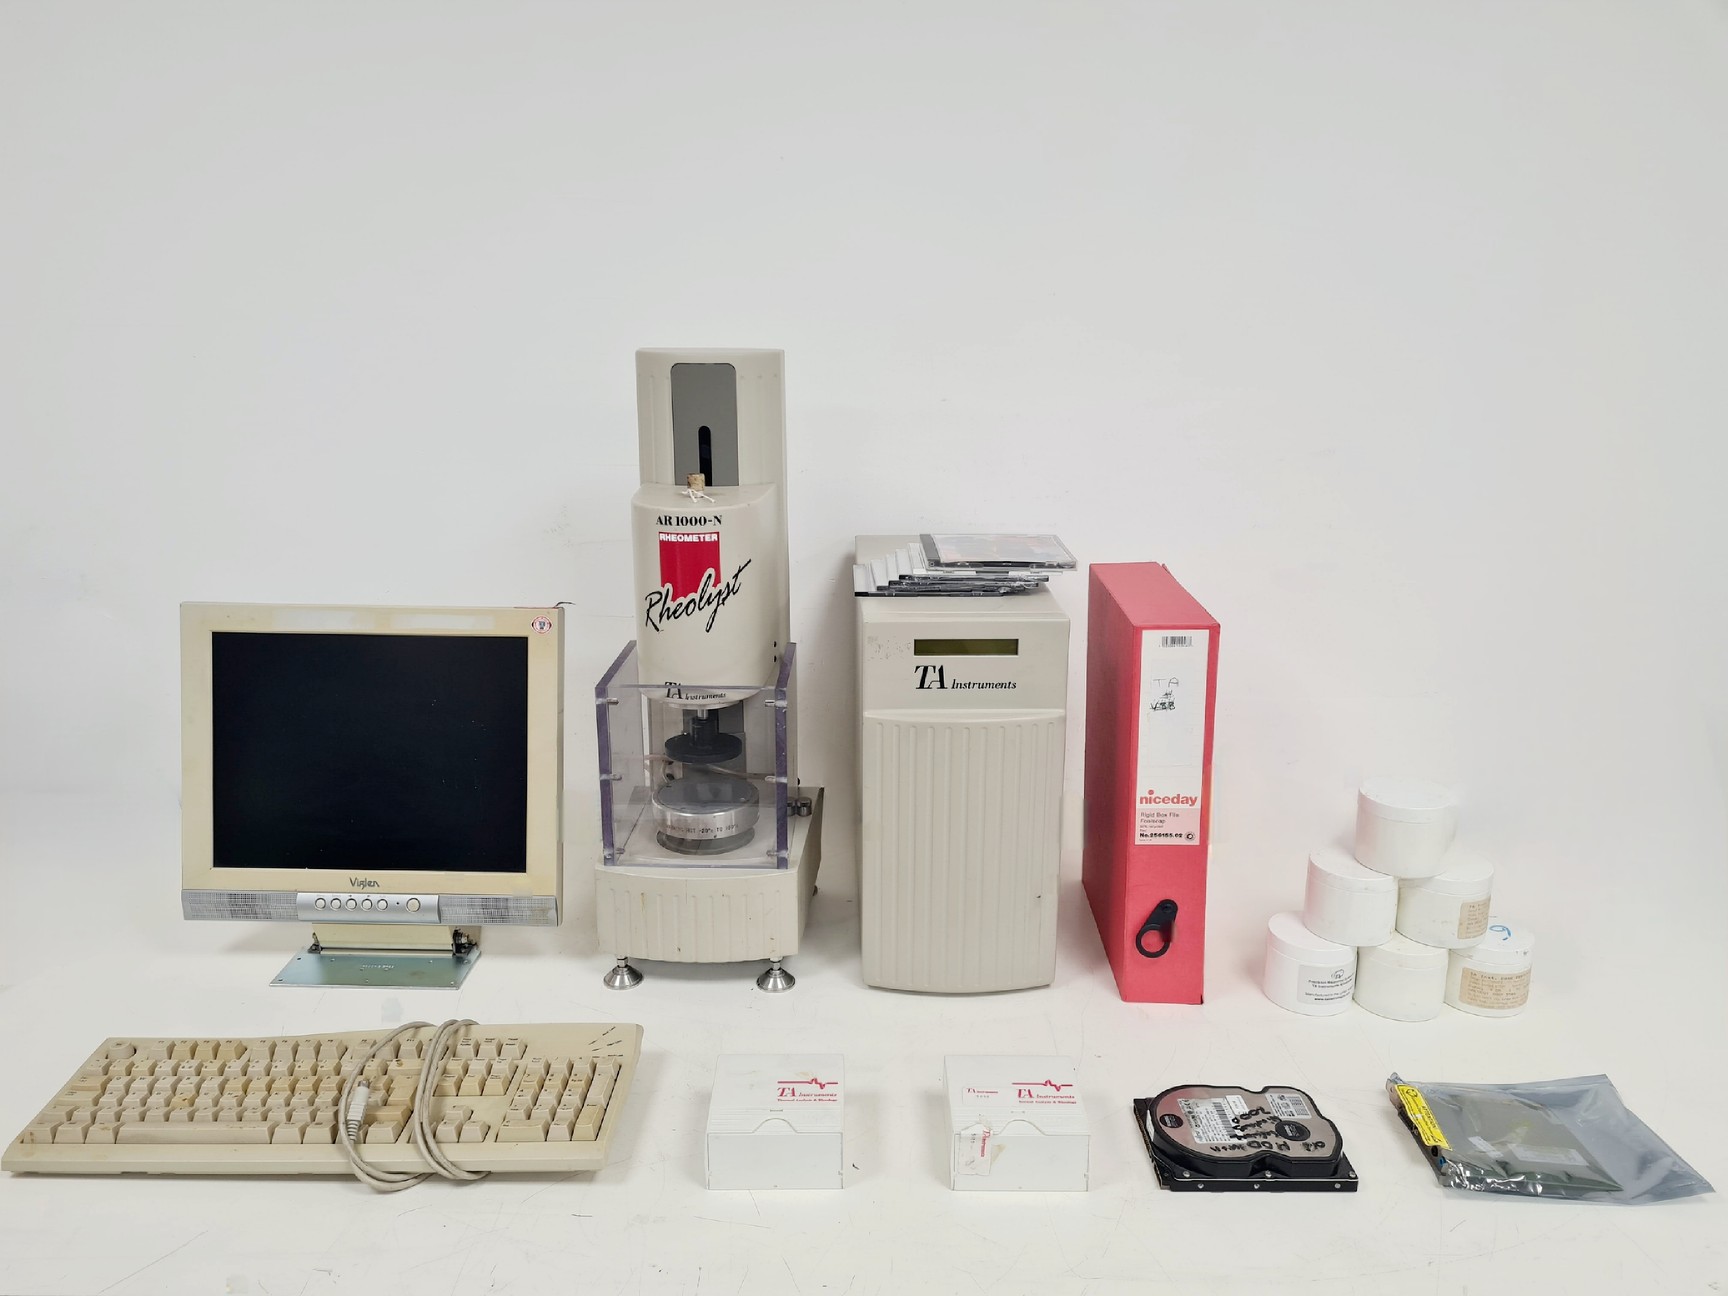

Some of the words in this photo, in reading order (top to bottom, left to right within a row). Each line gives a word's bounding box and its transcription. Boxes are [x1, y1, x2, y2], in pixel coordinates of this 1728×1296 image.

[659, 533, 718, 542] RHEOMETER
[645, 558, 752, 633] Rheolyst
[913, 664, 948, 690] TA
[951, 678, 1017, 690] Instruments
[1139, 789, 1198, 807] niceday
[349, 876, 380, 890] Viglen
[777, 1087, 796, 1097] TA
[1016, 1088, 1035, 1098] TA
